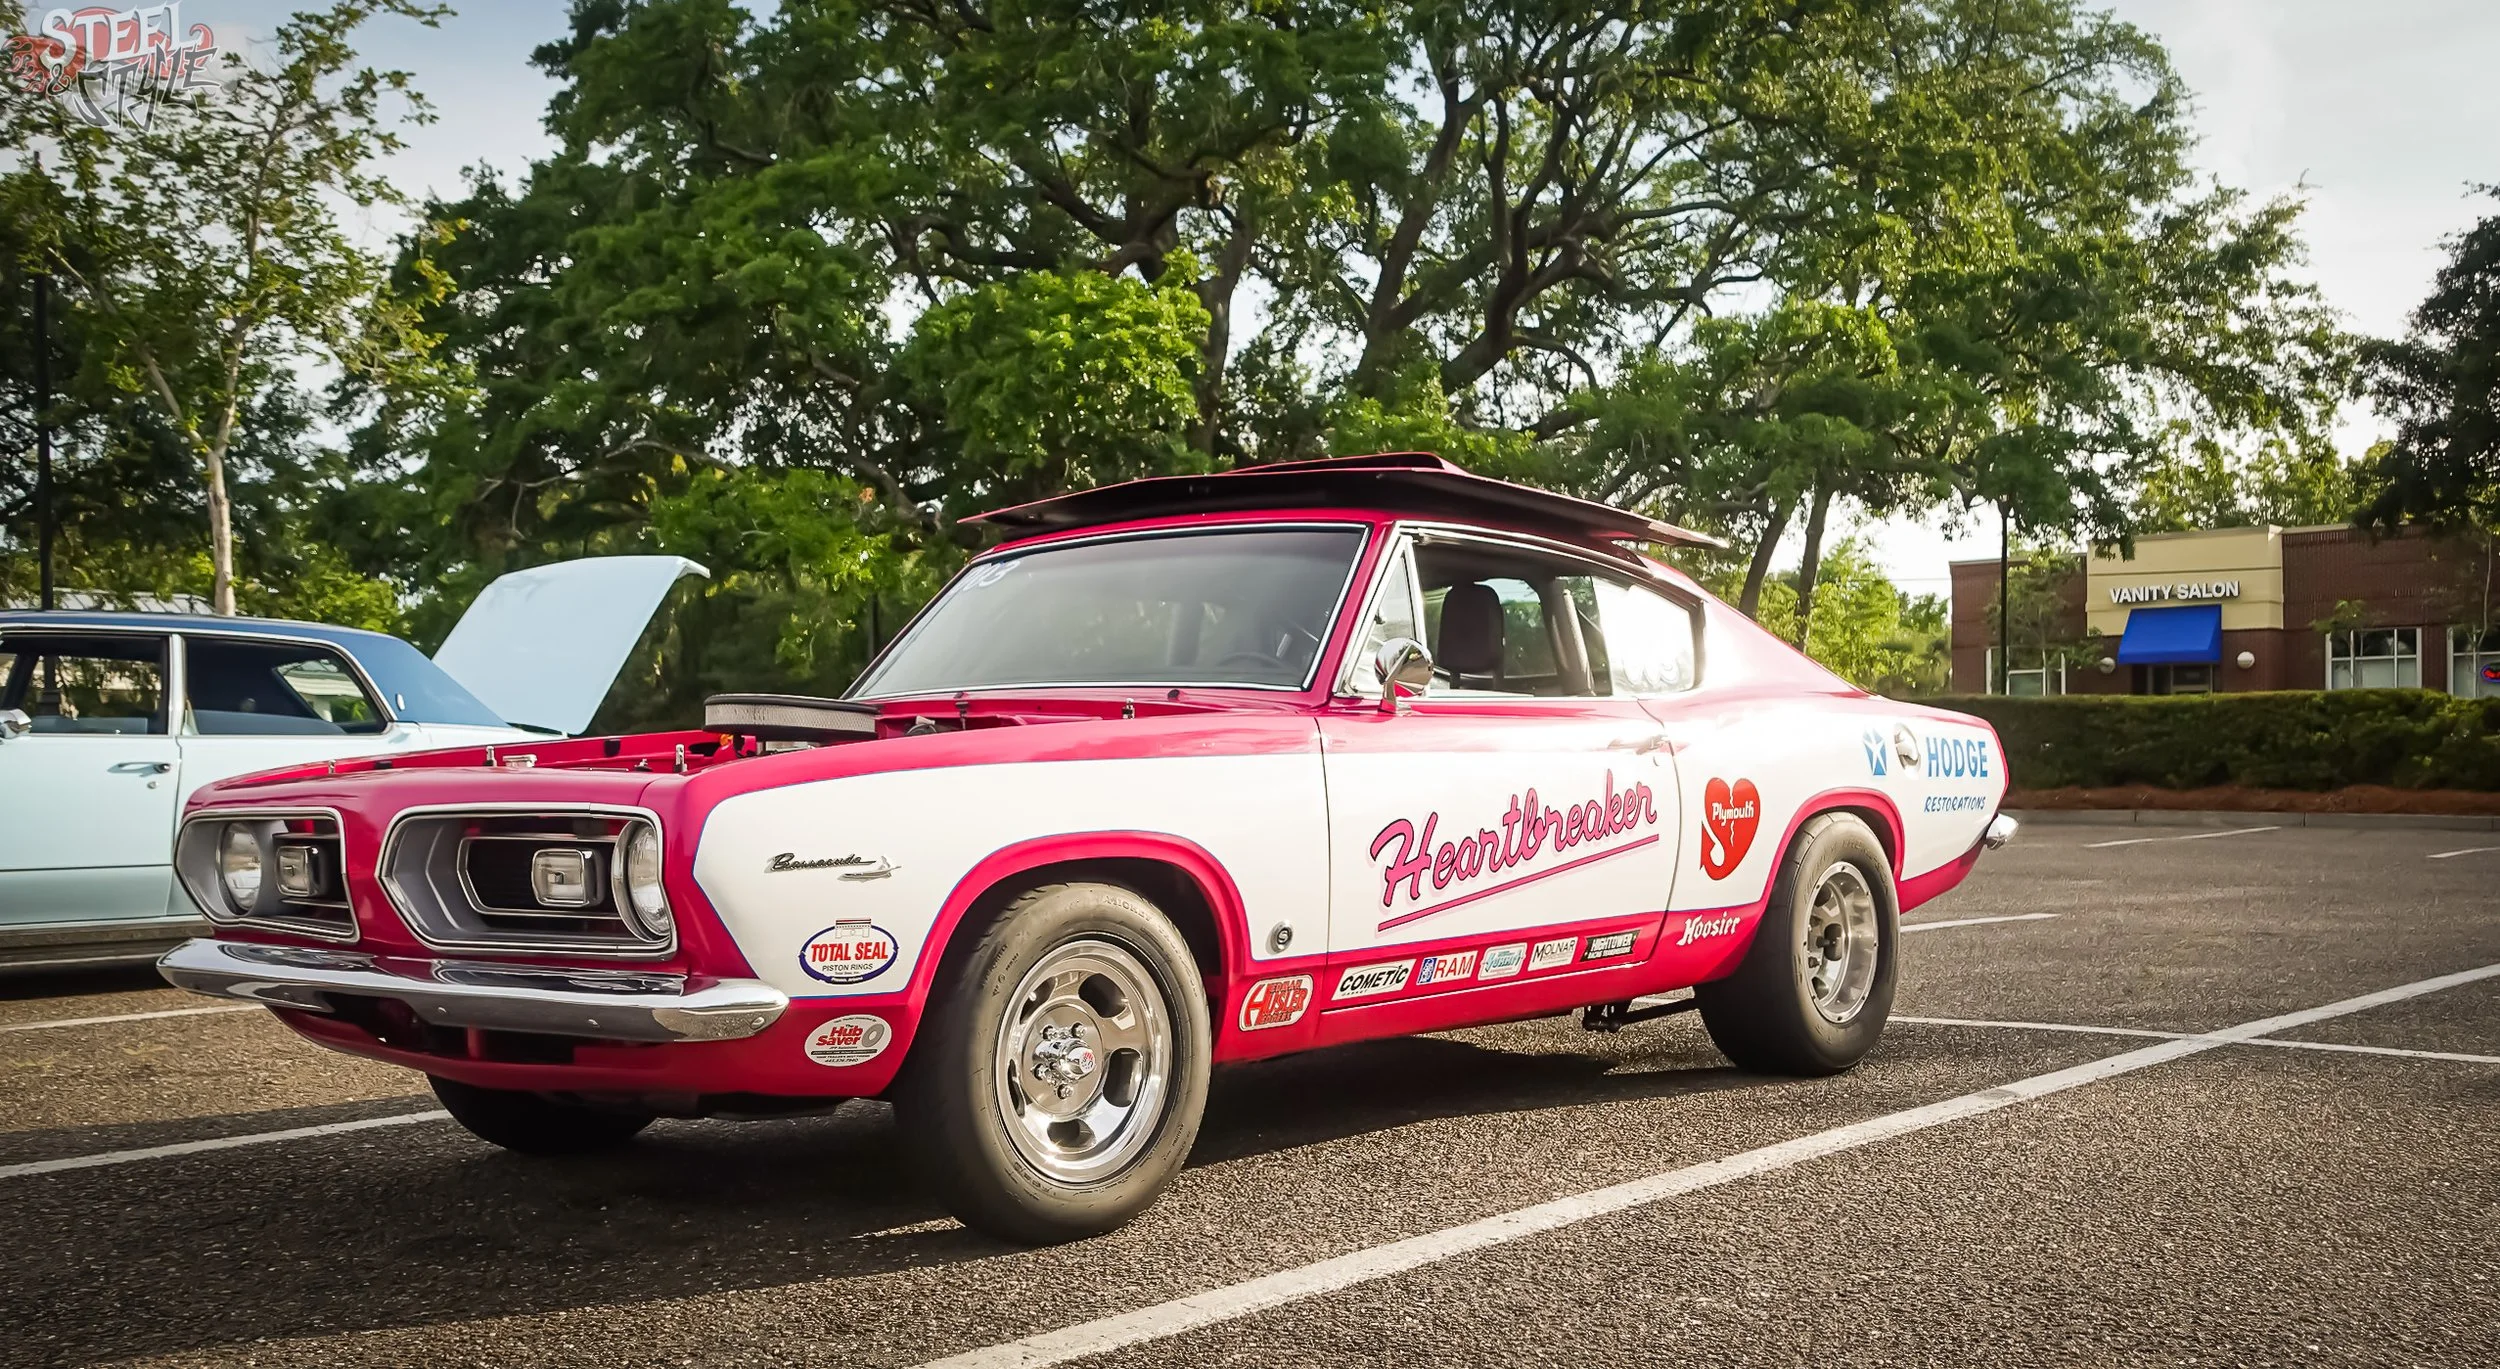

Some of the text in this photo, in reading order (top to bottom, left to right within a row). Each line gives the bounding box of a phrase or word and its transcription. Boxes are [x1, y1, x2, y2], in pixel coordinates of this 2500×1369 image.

[2109, 581, 2240, 604] VANITY SALON
[1925, 736, 1988, 778] HODGE
[1711, 801, 1755, 827] Plymouth
[1924, 796, 1986, 813] RESTORATIONS
[1369, 769, 1658, 907] Heartbreaker
[770, 852, 877, 871] Barracuda
[1676, 911, 1741, 946] Hoosier
[811, 941, 888, 962] TOTAL SEAL
[1532, 939, 1576, 963] MOLNAR
[1590, 933, 1634, 952] HIGHTOWER
[822, 963, 873, 972] PISTON RINGS
[1433, 954, 1475, 979] RAM
[1339, 965, 1409, 992] COMETIC
[816, 1035, 861, 1046] Saver
[830, 1025, 863, 1037] Hub
